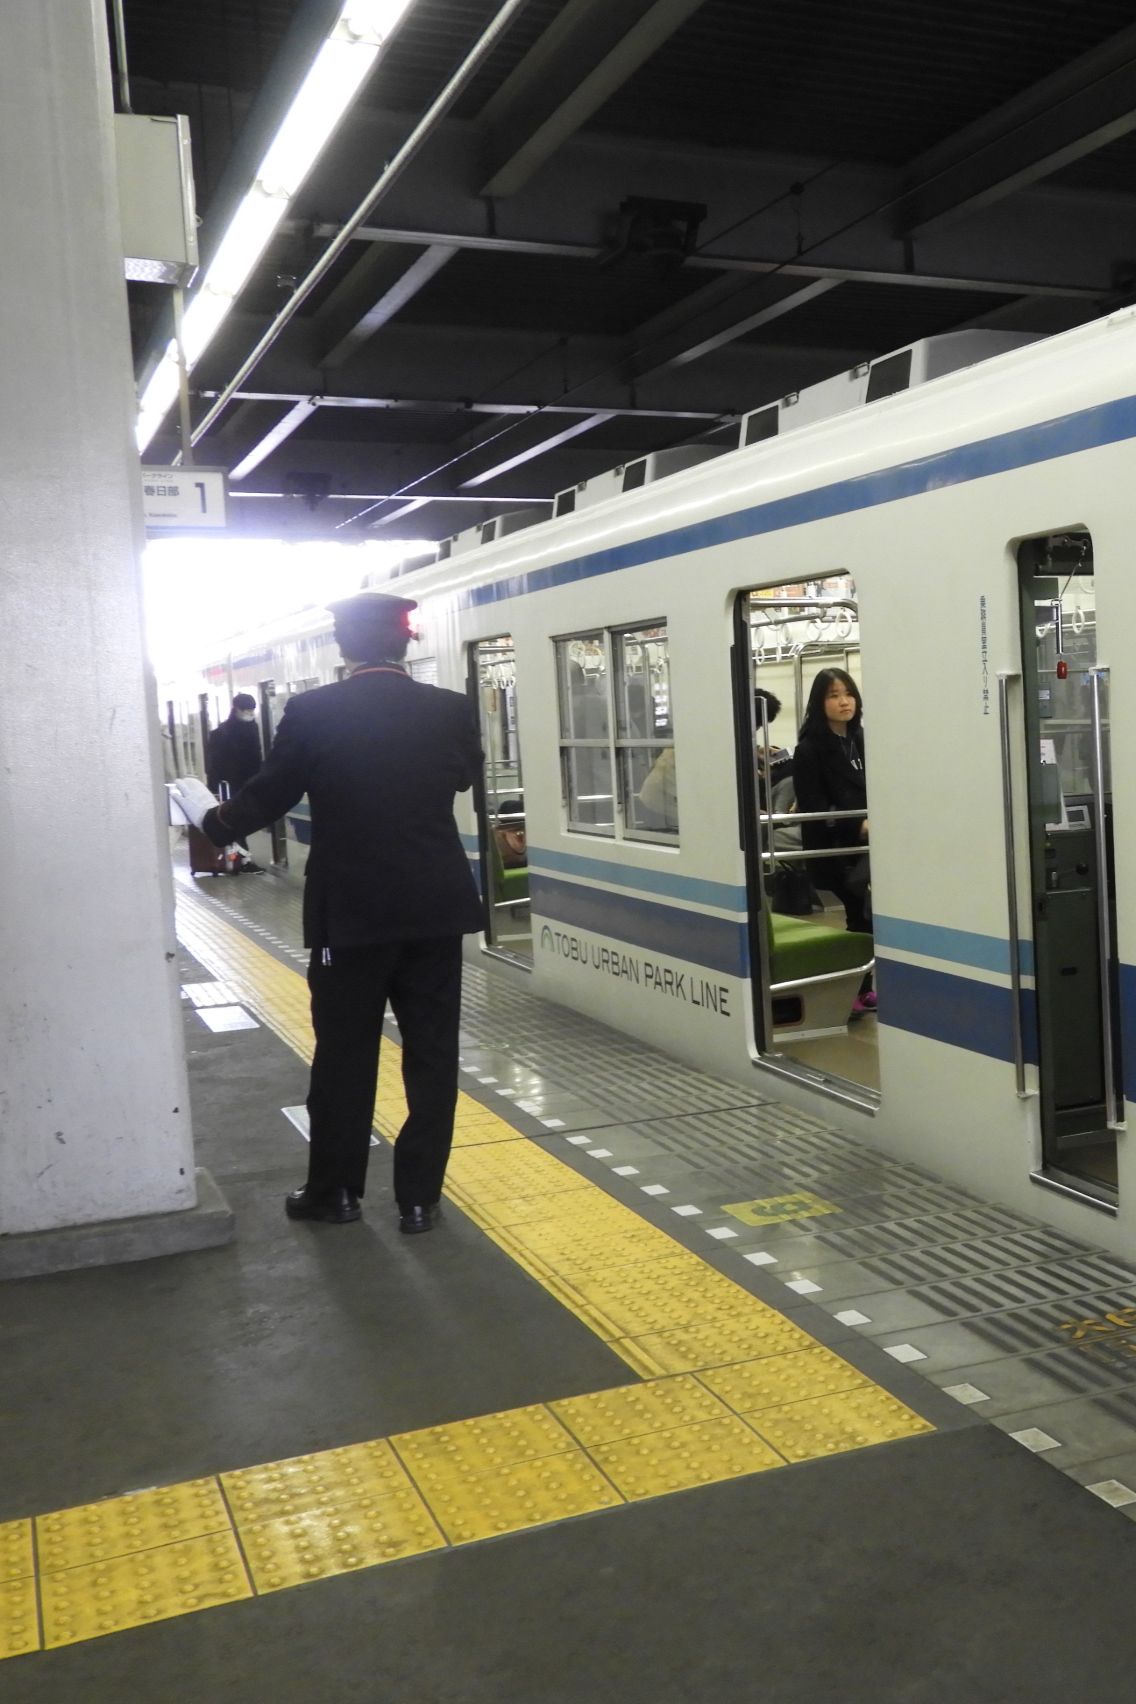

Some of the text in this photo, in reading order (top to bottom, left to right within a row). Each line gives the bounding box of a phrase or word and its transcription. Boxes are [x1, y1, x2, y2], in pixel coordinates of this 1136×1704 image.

[194, 482, 207, 514] 1
[554, 932, 731, 1017] TOBU URBAN PARK LINE
